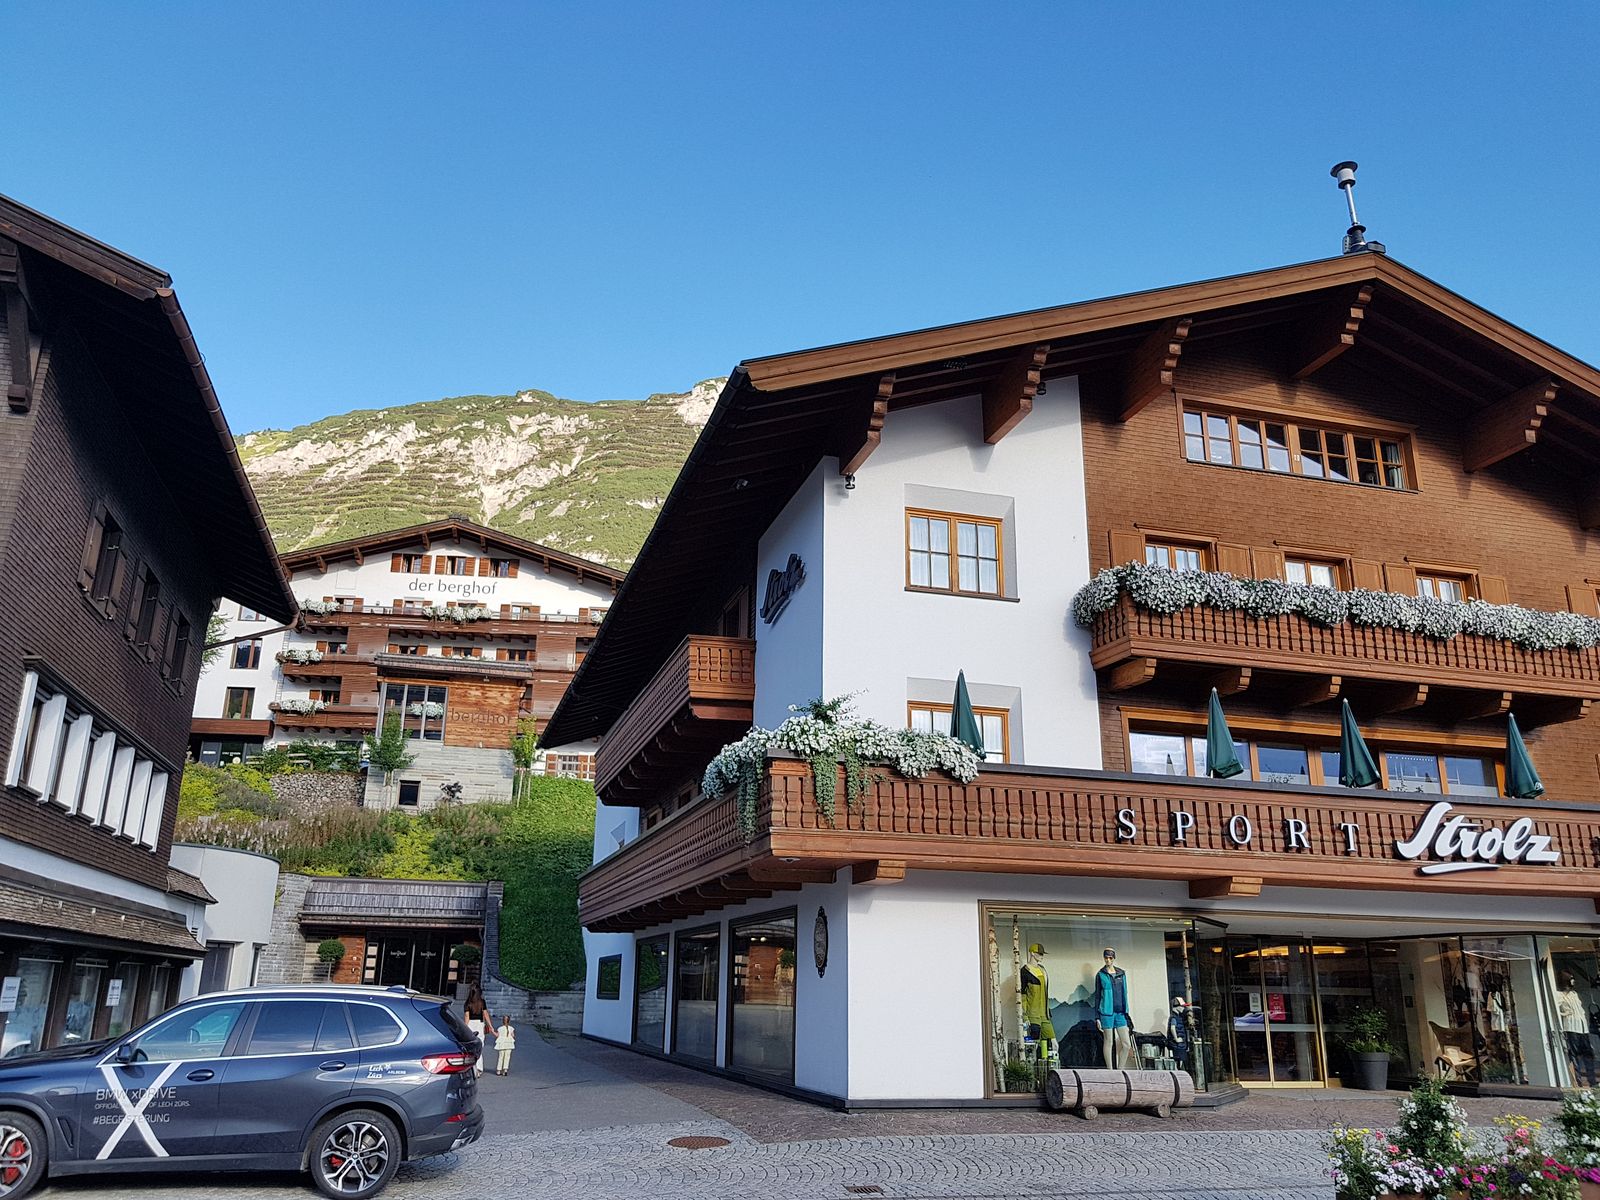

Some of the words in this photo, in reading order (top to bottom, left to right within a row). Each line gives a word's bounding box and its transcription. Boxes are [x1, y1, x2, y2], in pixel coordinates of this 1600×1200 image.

[408, 578, 434, 592] der
[438, 579, 498, 597] berghof
[451, 708, 511, 726] berghof
[1117, 808, 1360, 852] SPORT
[1395, 801, 1561, 864] Strolz
[96, 1088, 128, 1101] BMW
[131, 1087, 177, 1100] xDRIVE
